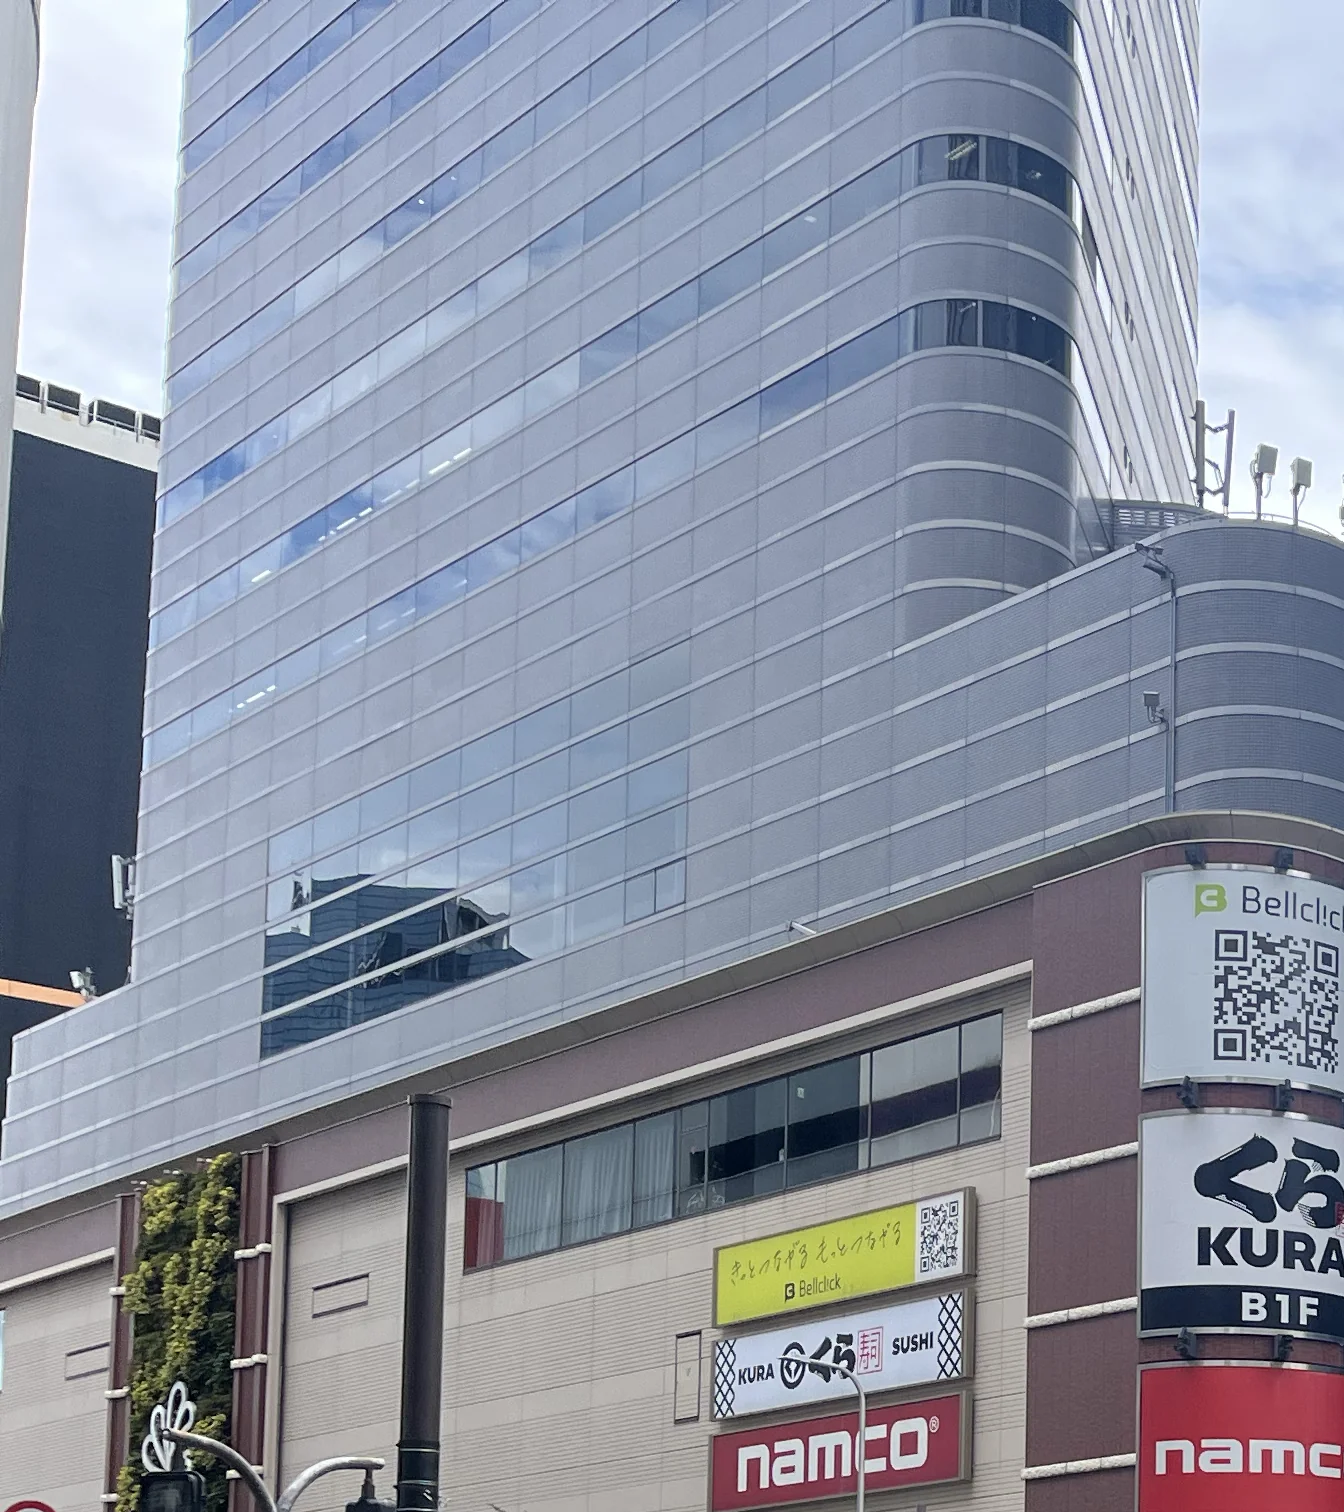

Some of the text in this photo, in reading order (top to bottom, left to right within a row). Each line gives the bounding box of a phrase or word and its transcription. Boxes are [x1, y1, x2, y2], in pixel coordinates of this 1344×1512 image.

[1241, 1291, 1319, 1325] B1F
[892, 1331, 935, 1357] SUSHI
[738, 1366, 775, 1386] KURA
